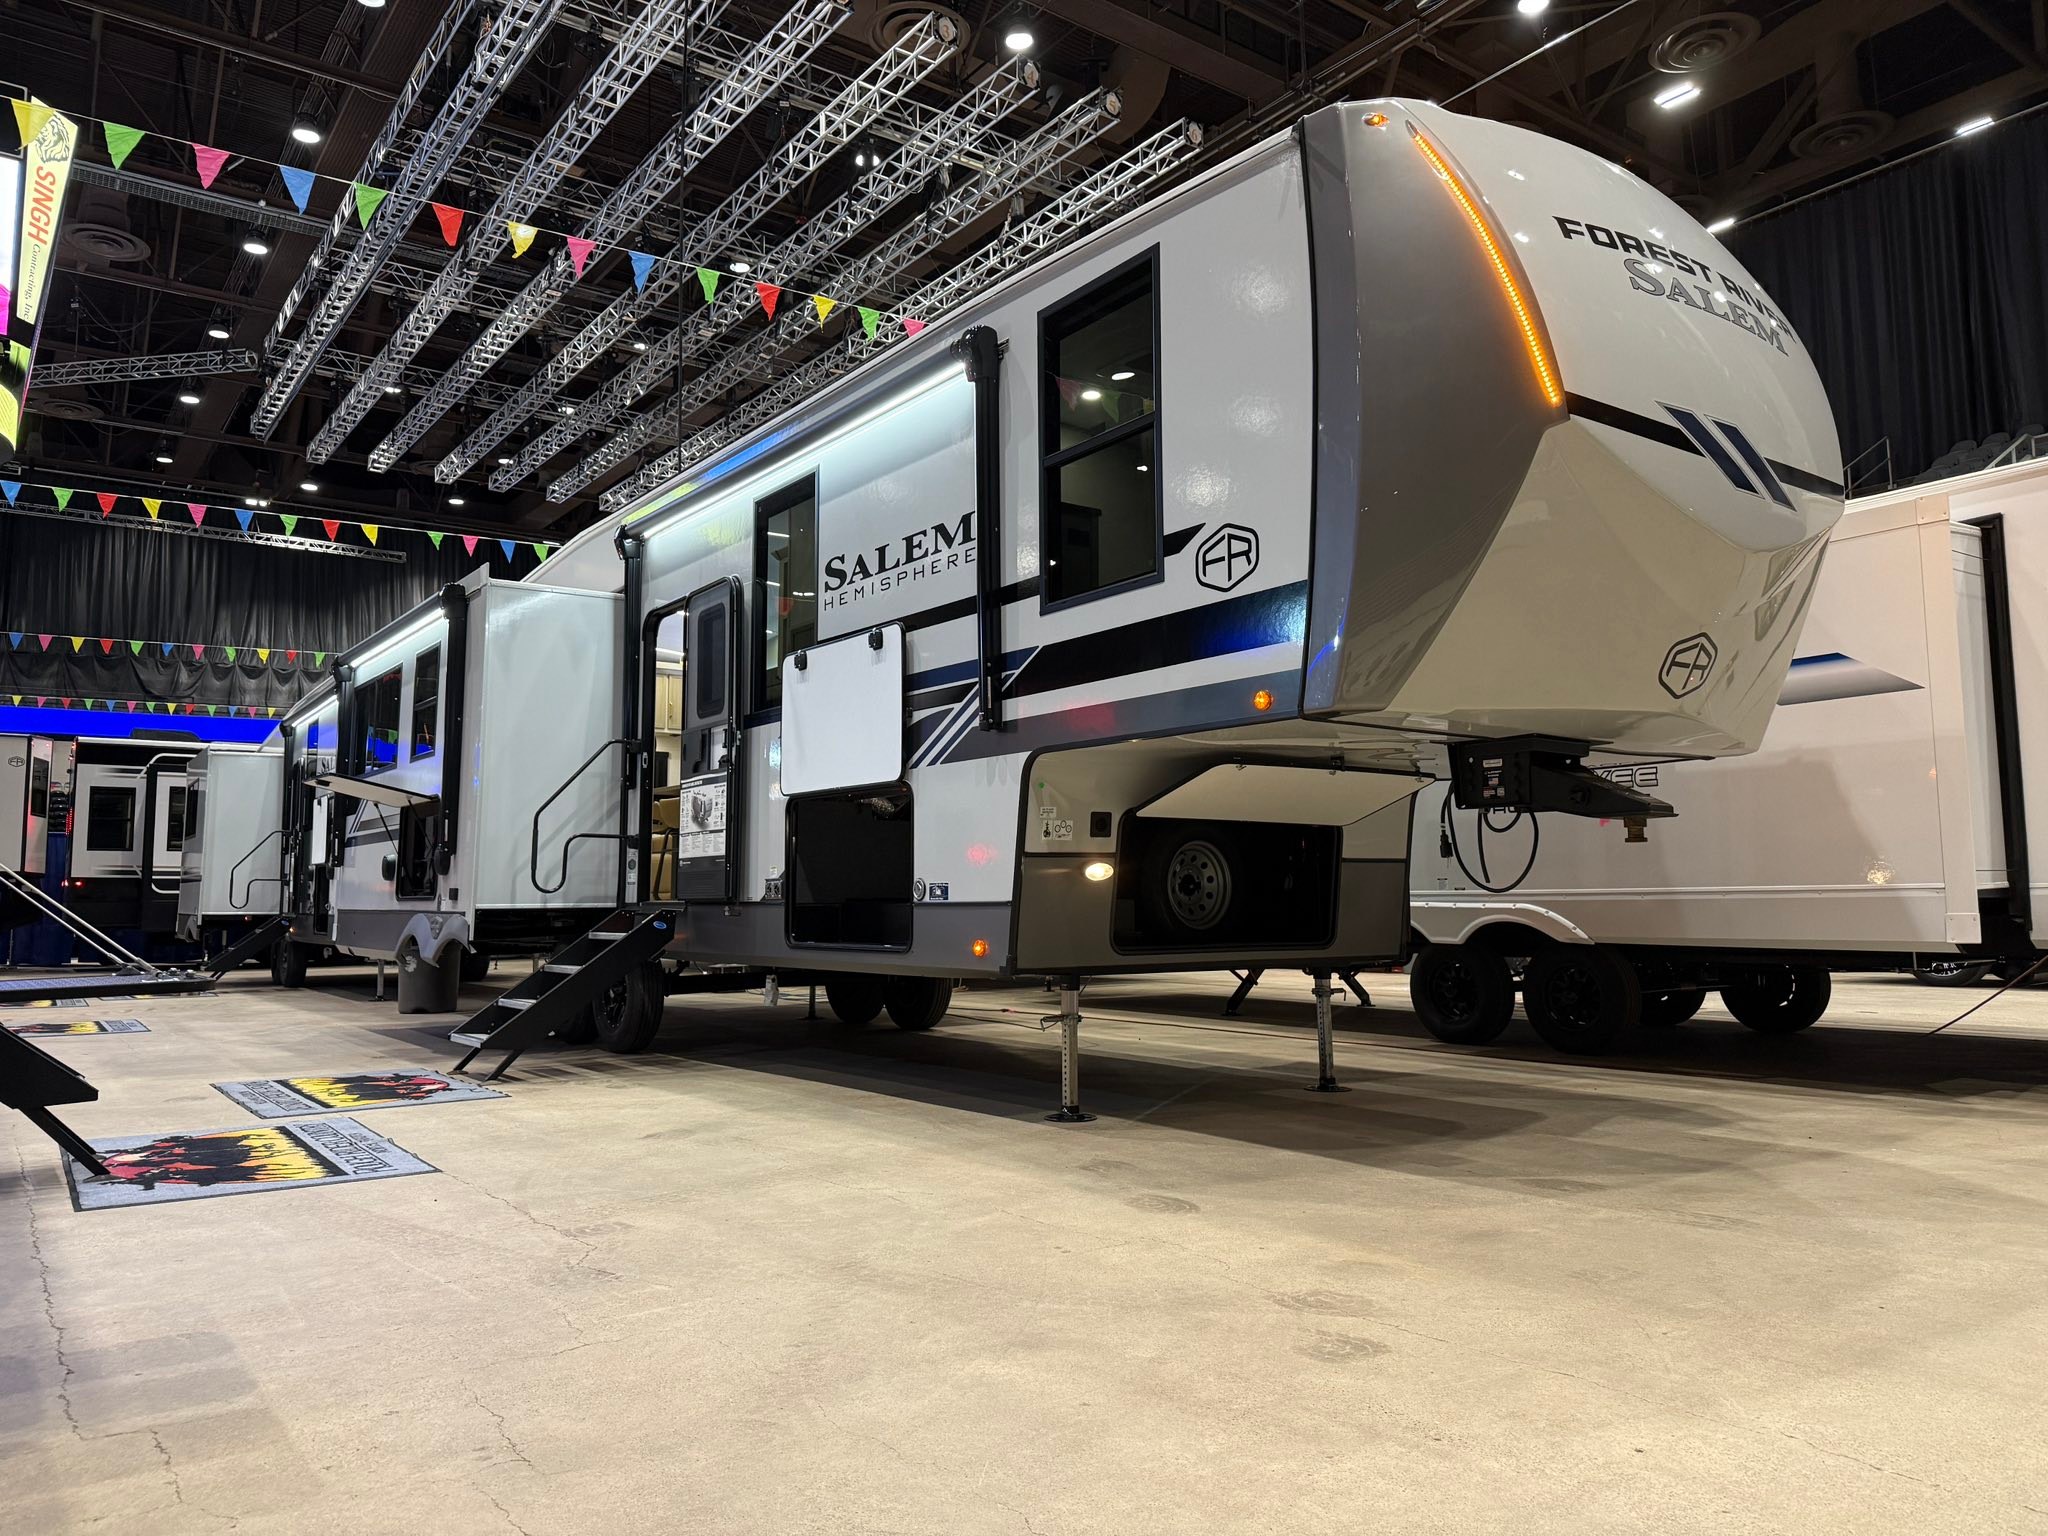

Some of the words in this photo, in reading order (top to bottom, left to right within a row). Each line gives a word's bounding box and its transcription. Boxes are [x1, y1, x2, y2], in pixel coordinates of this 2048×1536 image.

[27, 165, 56, 246] SINGH
[1552, 215, 1712, 283] FOREST
[1716, 271, 1797, 345] RIVER
[1623, 257, 1789, 357] SALEM
[824, 510, 976, 593] SALEM
[824, 546, 976, 612] HEMISPHERE
